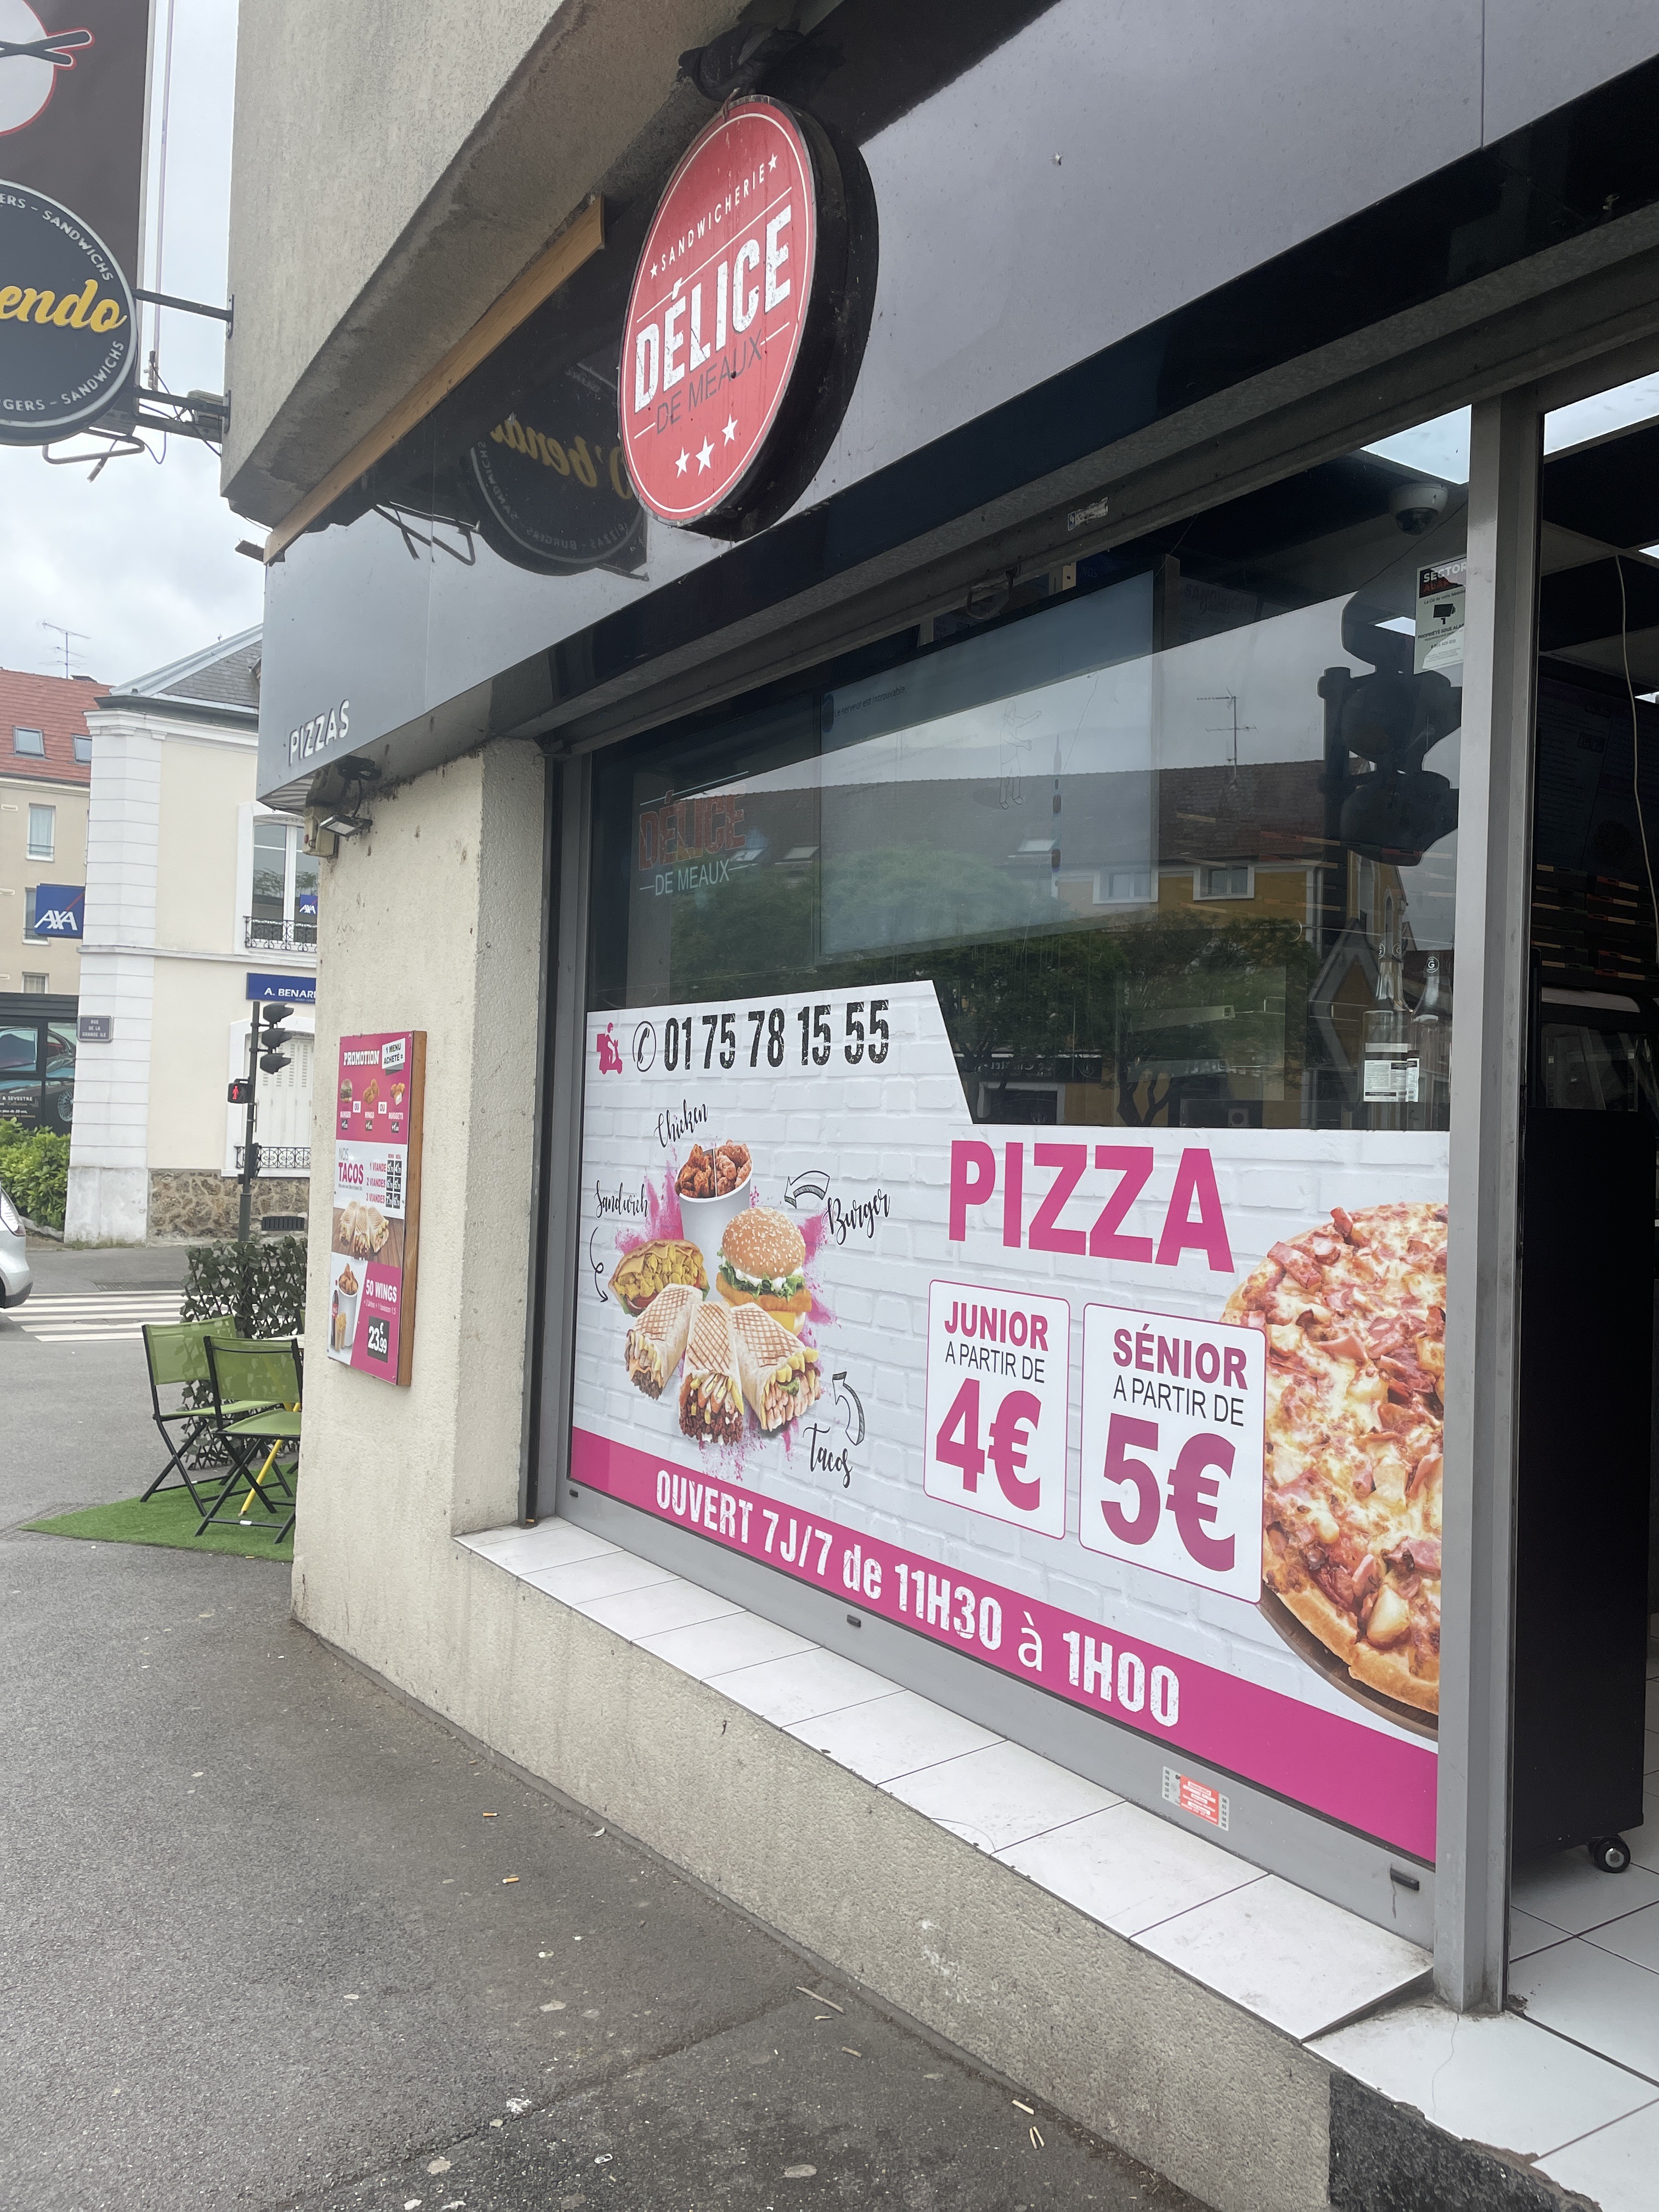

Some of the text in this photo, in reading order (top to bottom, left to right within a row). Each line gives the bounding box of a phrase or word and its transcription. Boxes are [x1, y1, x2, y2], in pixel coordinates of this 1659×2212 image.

[661, 163, 764, 272] SANDWICHERIE
[42, 210, 114, 280] SANDWICHS
[635, 205, 792, 413] DÉLICE
[0, 341, 124, 411] GERS SANDWICHS
[657, 329, 763, 434] DE MEAUX
[1423, 564, 1466, 583] SECTOR
[841, 702, 862, 714] serveur
[862, 697, 872, 708] est
[873, 685, 907, 704] introuvable.
[289, 699, 349, 766] PIZZAS
[639, 783, 746, 871] DÉLICE
[656, 859, 730, 896] DE MEAUX
[34, 910, 78, 931] AXA
[300, 904, 316, 915] AXA
[264, 987, 275, 996] A.
[343, 1050, 380, 1066] PROMOTION
[383, 1052, 400, 1065] ACHETÉ
[389, 1043, 402, 1052] MENU
[664, 1000, 889, 1071] 01 75 78 15 55
[654, 1099, 708, 1148] Chicken
[338, 1148, 349, 1161] NOS
[338, 1162, 364, 1184] TACOS
[373, 1163, 387, 1172] VIANDE
[366, 1177, 369, 1186] 2
[370, 1177, 386, 1188] VIANDES
[369, 1193, 385, 1204] VIANDES
[594, 1180, 650, 1219] Sandwich
[949, 1139, 1235, 1273] PIZZA
[823, 1189, 890, 1245] Burger
[366, 1279, 397, 1304] 50 WINGS
[945, 1301, 1048, 1351] JUNIOR
[945, 1341, 1045, 1384] A PARTIR DE
[1113, 1323, 1248, 1390] SÉNIOR
[1114, 1375, 1244, 1427] A PARTIR DE
[802, 1422, 853, 1488] Tacos
[936, 1378, 1041, 1511] 4€
[1100, 1412, 1236, 1572] 5€
[656, 1470, 1180, 1728] OUVERT 7J/7 de 11H30 à 1H00
